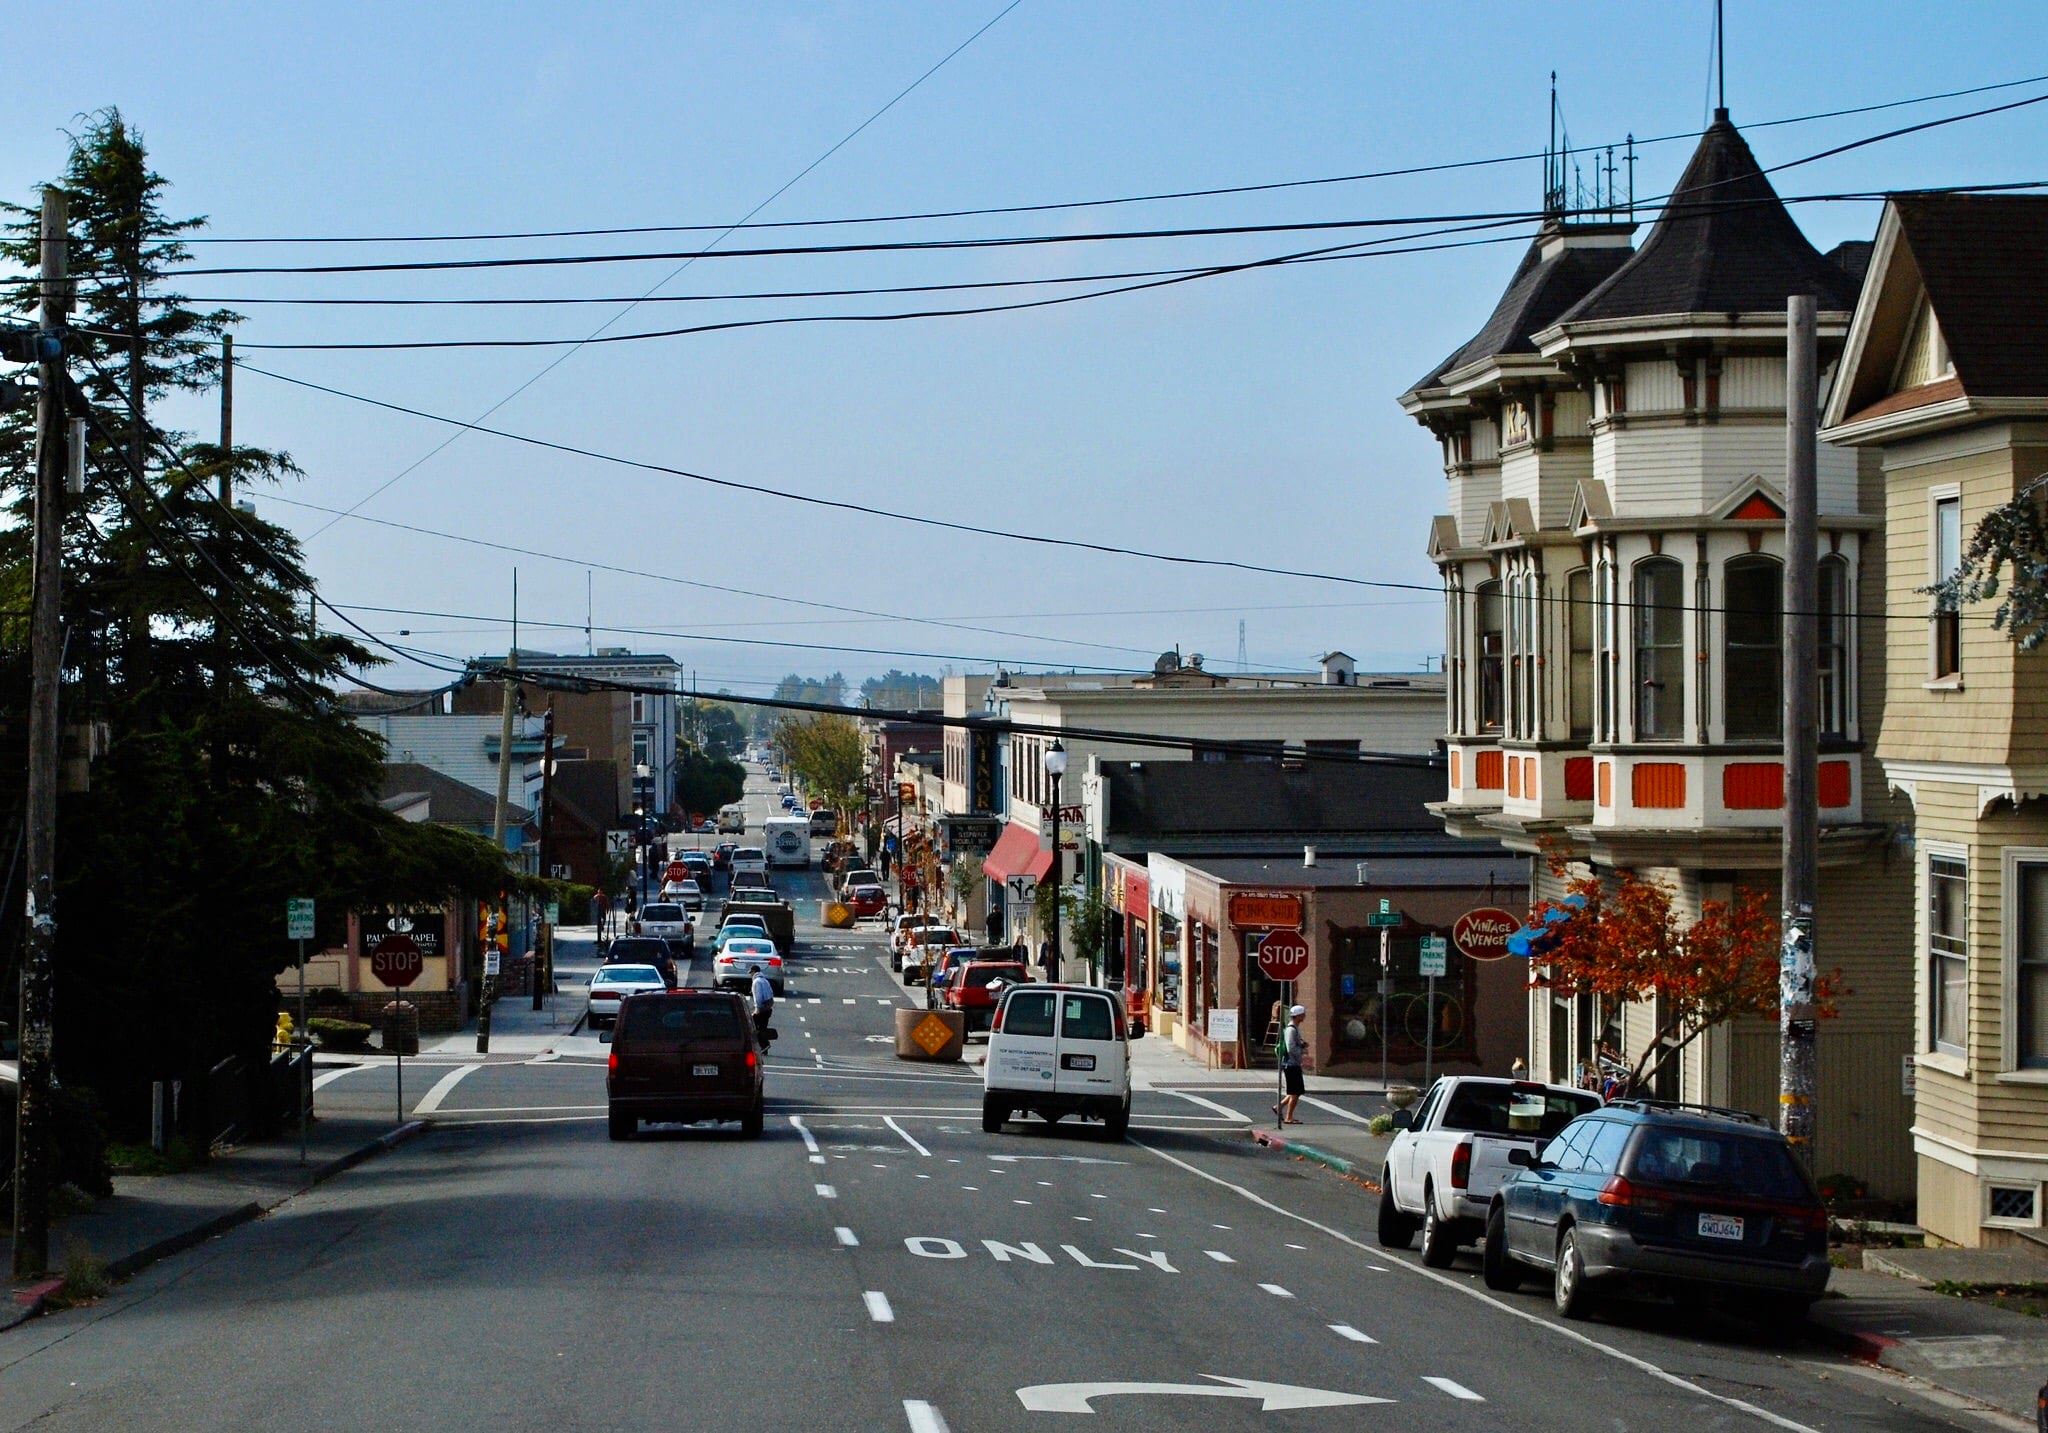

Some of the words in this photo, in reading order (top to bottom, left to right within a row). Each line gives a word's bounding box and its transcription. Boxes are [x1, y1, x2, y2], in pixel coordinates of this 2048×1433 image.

[668, 867, 687, 876] STOP
[1465, 916, 1511, 934] VINTAGE
[375, 951, 419, 971] STOP
[1262, 945, 1306, 965] STOP
[1422, 951, 1444, 960] PARKING
[803, 966, 869, 974] ONLY
[903, 1236, 1181, 1273] ONLY
